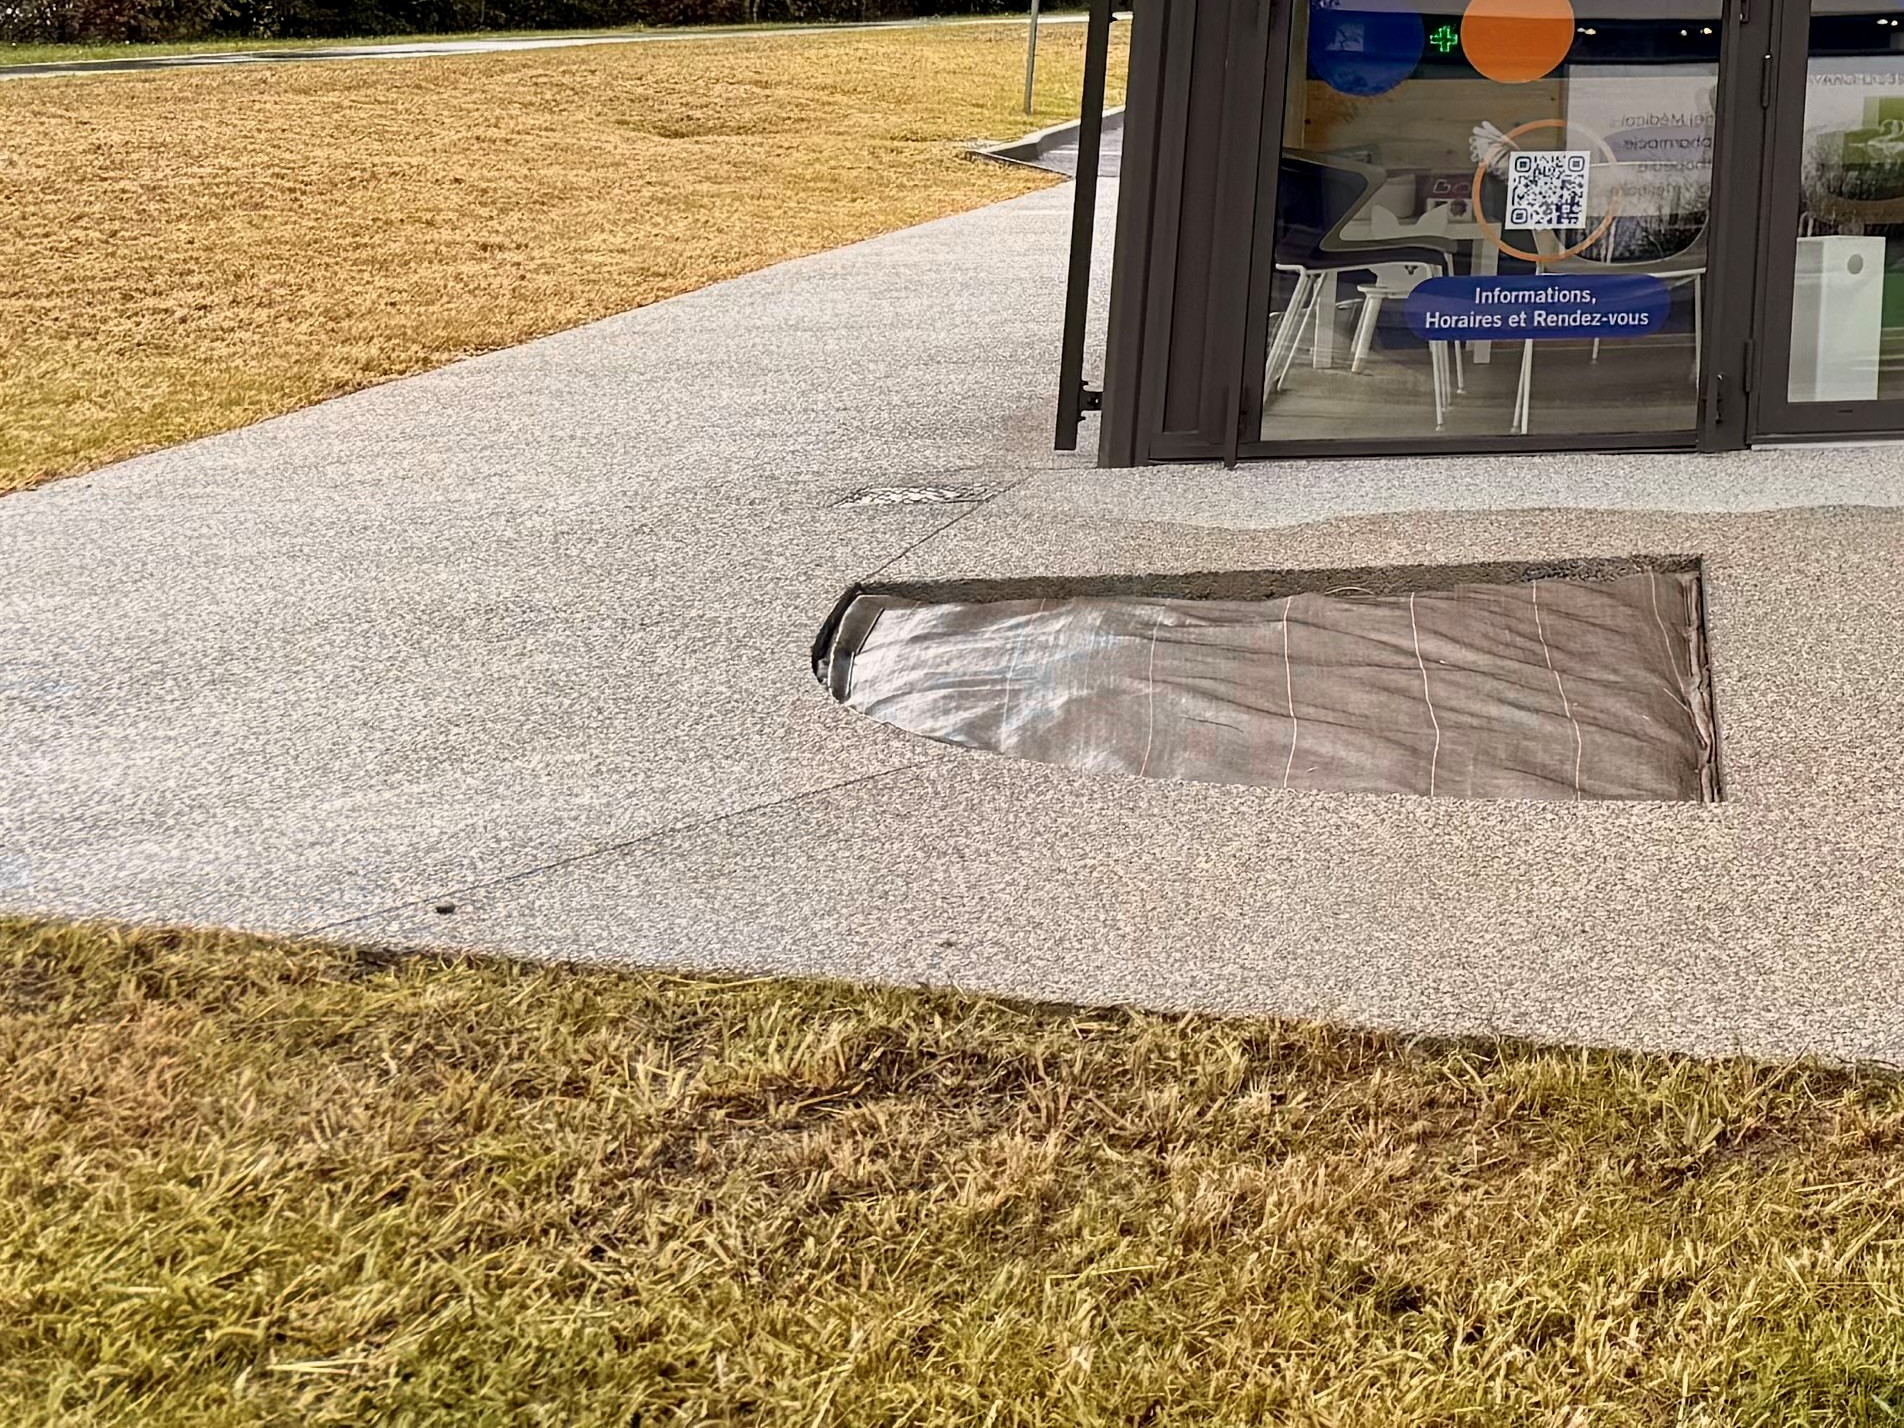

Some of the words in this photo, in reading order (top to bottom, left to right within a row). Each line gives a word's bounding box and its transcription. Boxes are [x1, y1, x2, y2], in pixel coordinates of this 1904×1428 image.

[1474, 286, 1597, 305] Informations,
[1425, 310, 1502, 329] Horaires
[1508, 311, 1527, 327] et
[1533, 309, 1649, 327] Rendez-vous
